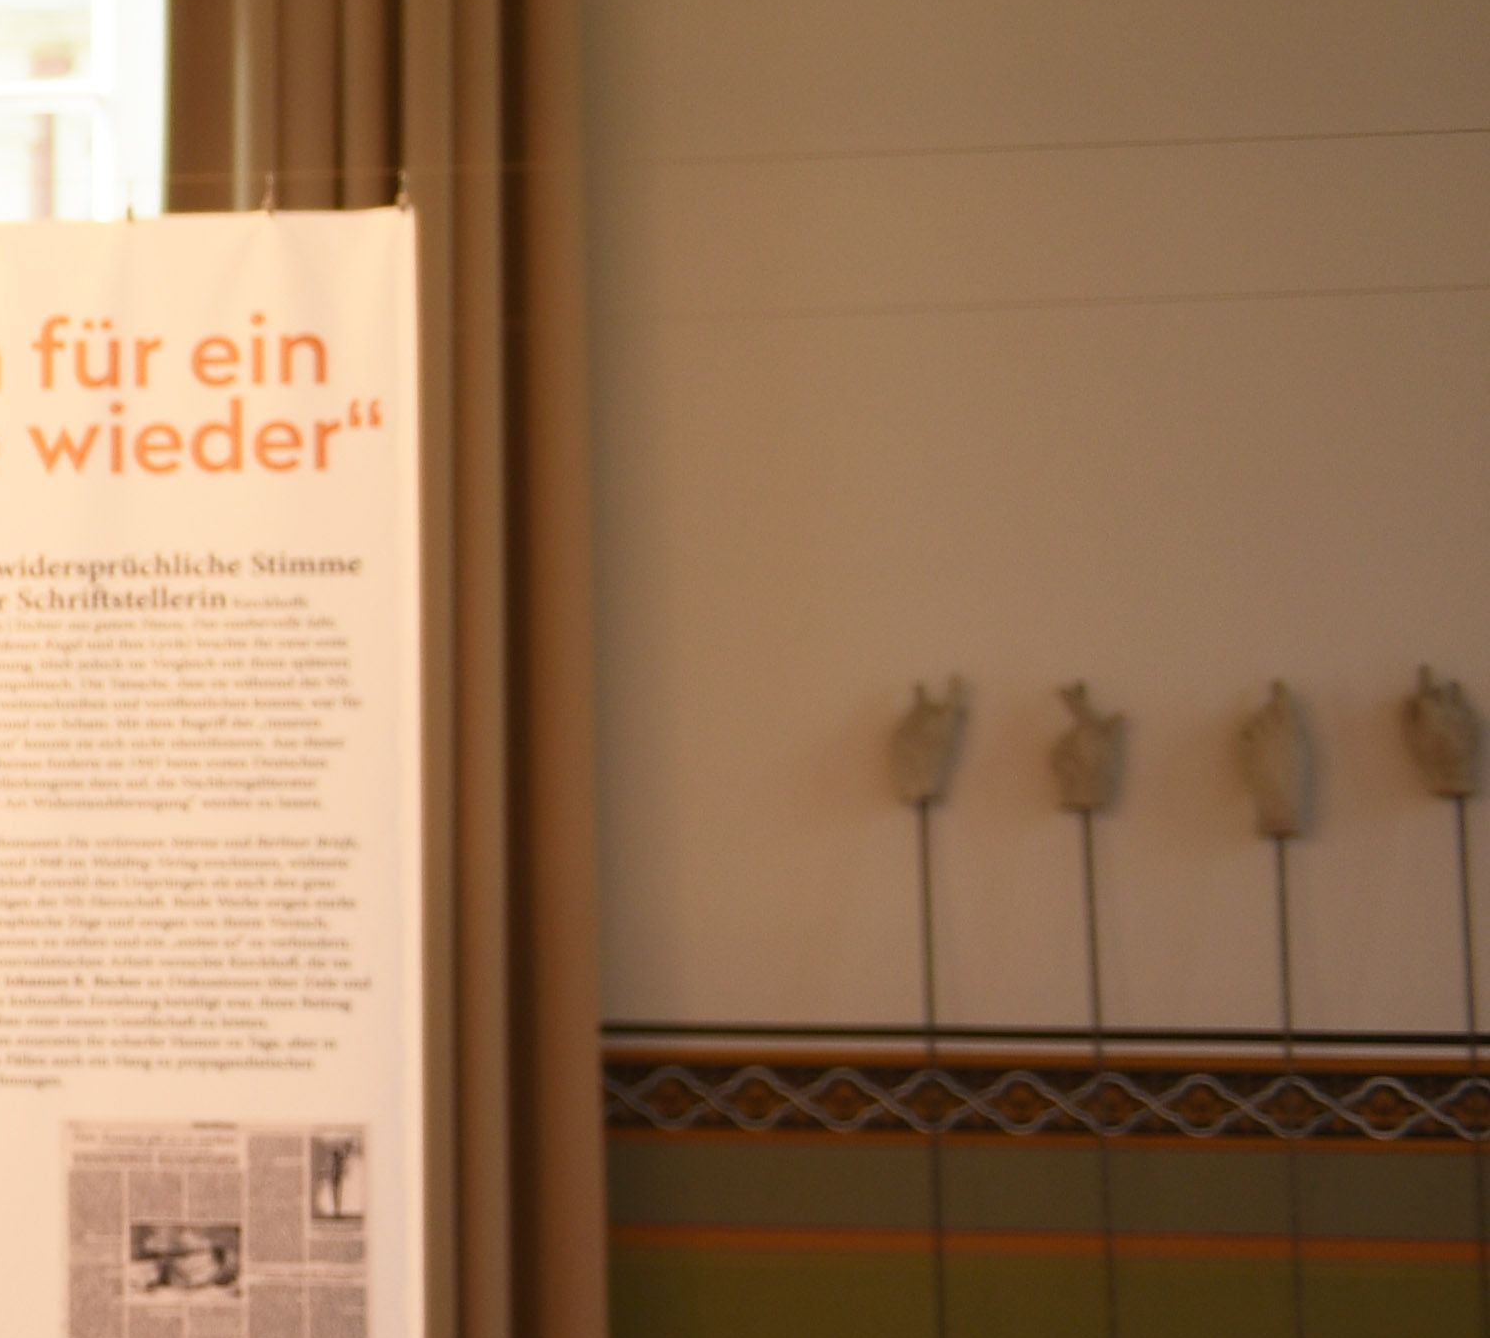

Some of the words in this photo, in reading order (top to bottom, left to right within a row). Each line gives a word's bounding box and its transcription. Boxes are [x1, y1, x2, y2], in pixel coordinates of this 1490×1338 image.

[31, 315, 163, 391] für
[190, 312, 330, 389] ein
[27, 396, 383, 476] wieder“
[252, 553, 361, 576] Stimme
[17, 586, 227, 611] Schriftstellerin
